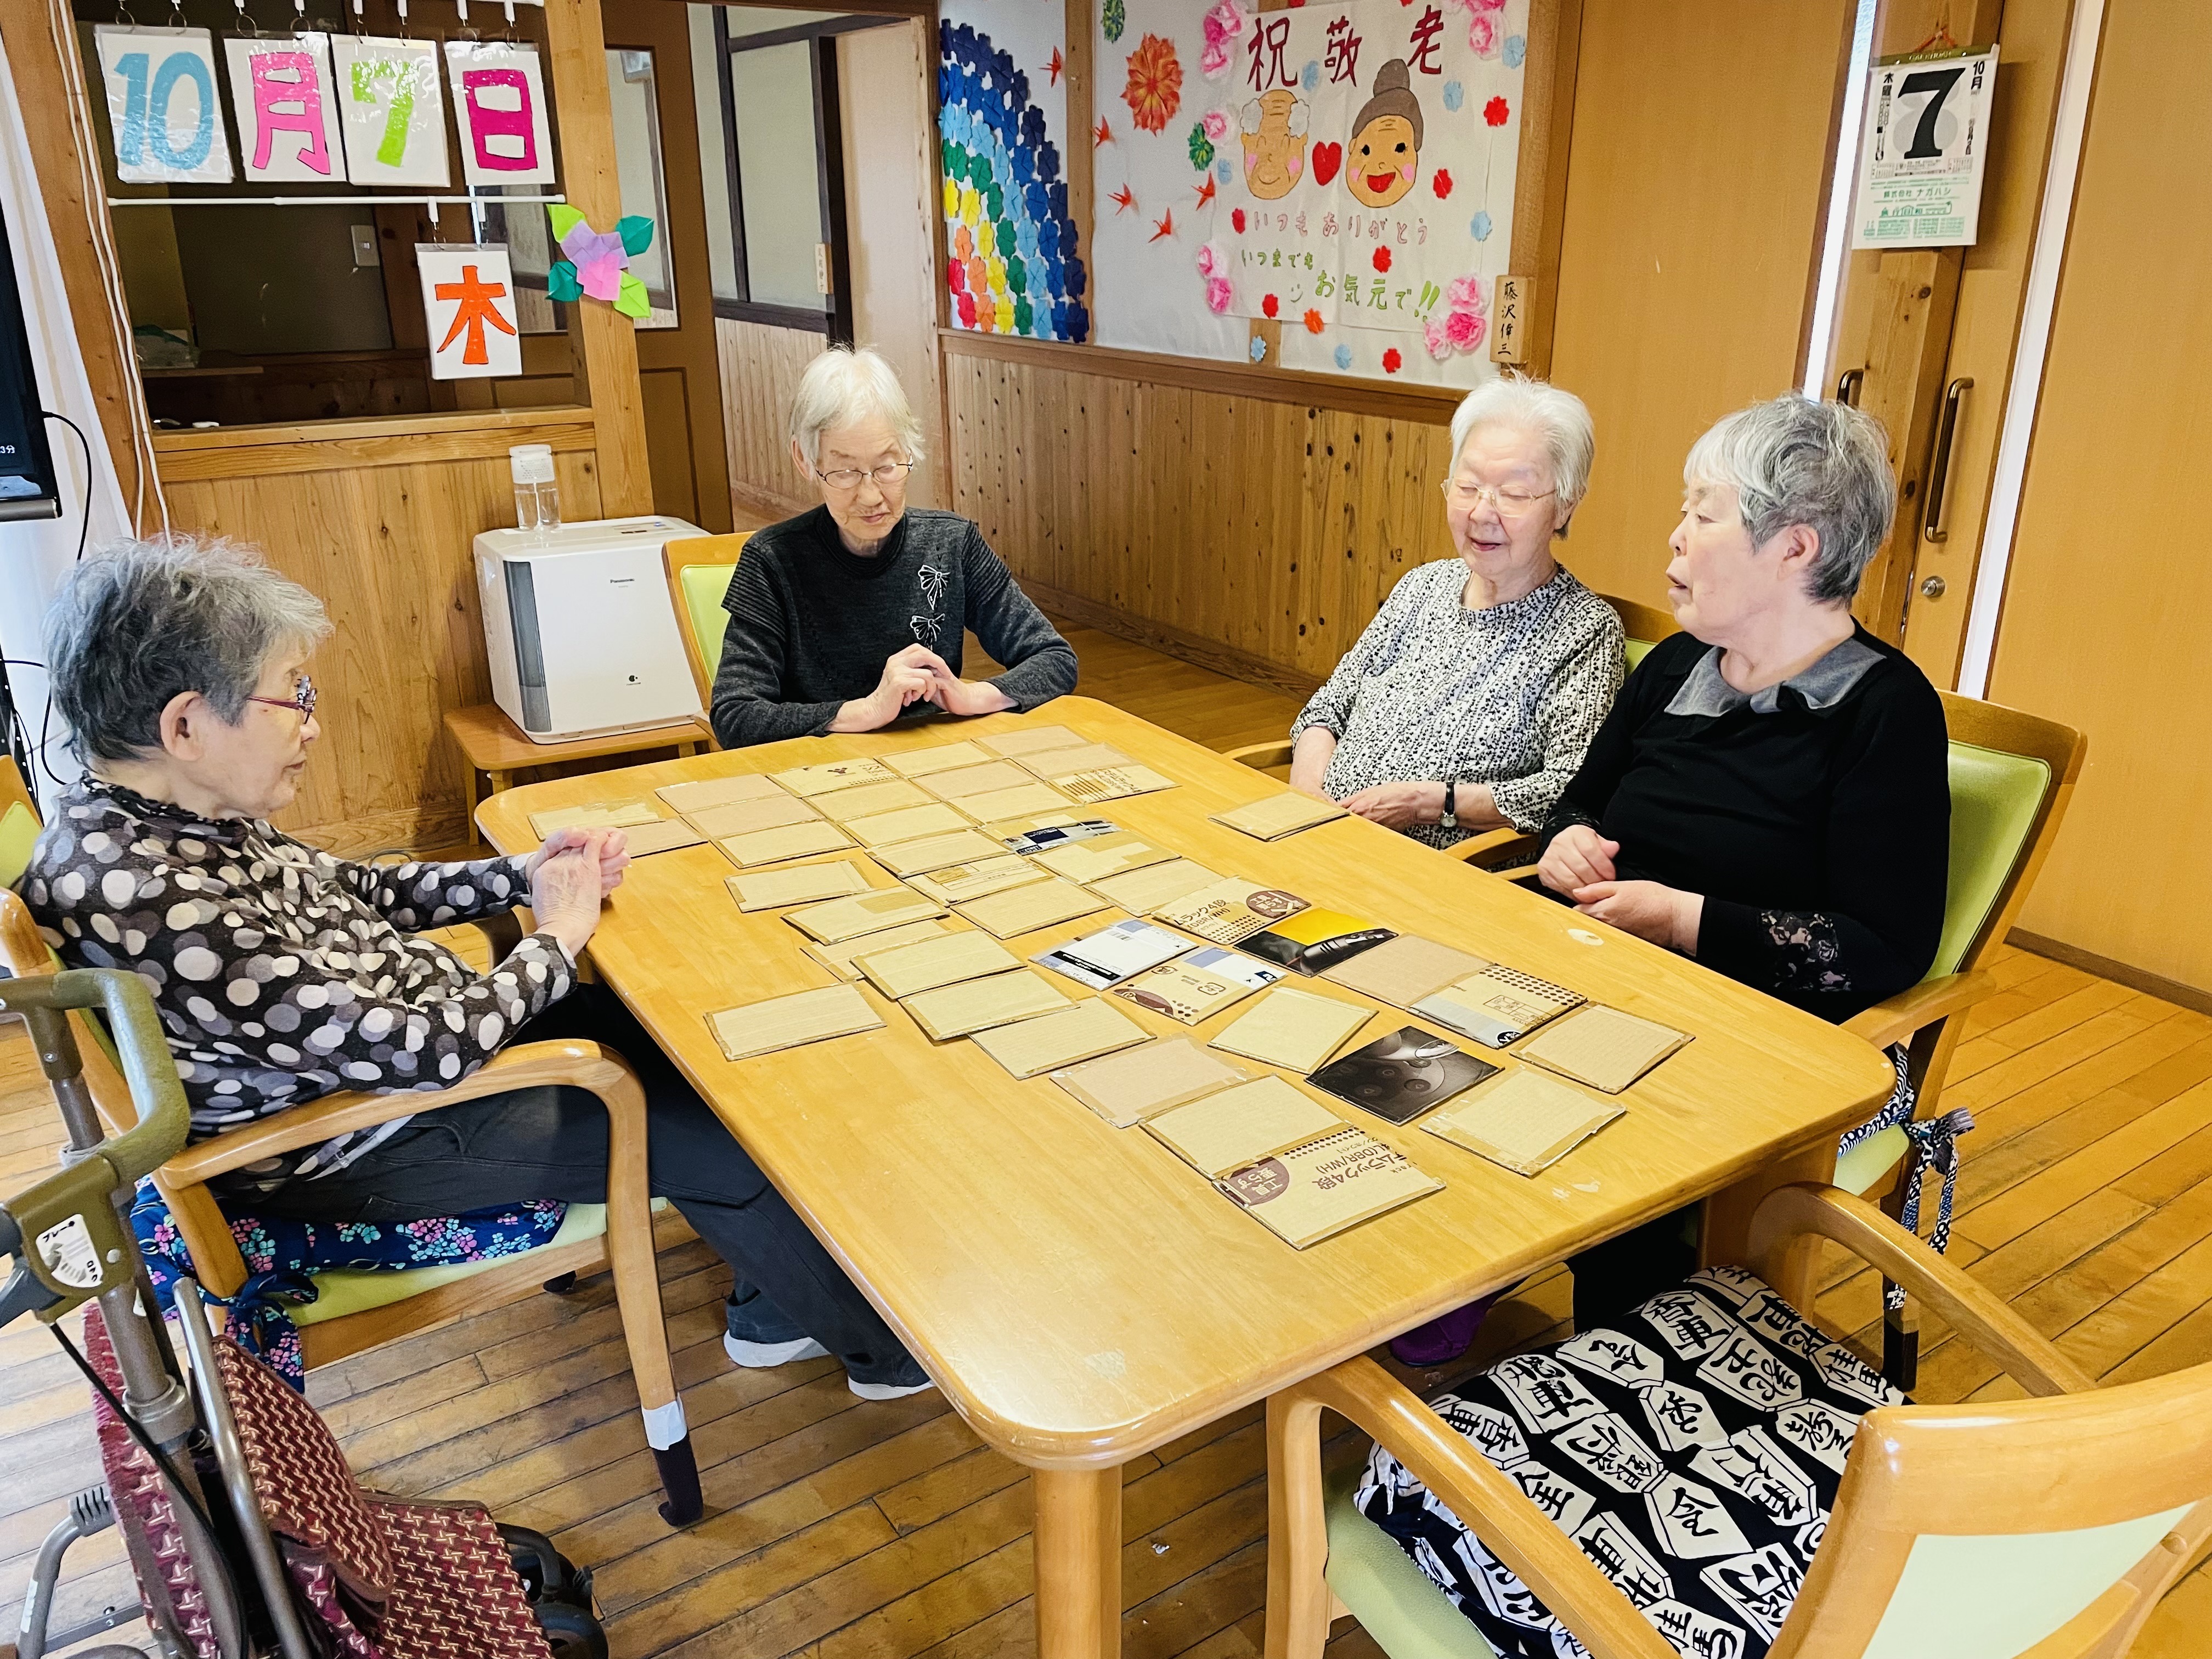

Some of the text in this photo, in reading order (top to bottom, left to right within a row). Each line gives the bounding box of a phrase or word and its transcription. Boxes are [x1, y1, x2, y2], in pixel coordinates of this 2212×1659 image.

[1898, 67, 1966, 160] 7
[1916, 187, 1951, 198] ナガハシ
[1241, 248, 1313, 270] いつまでも
[435, 266, 517, 365] 木
